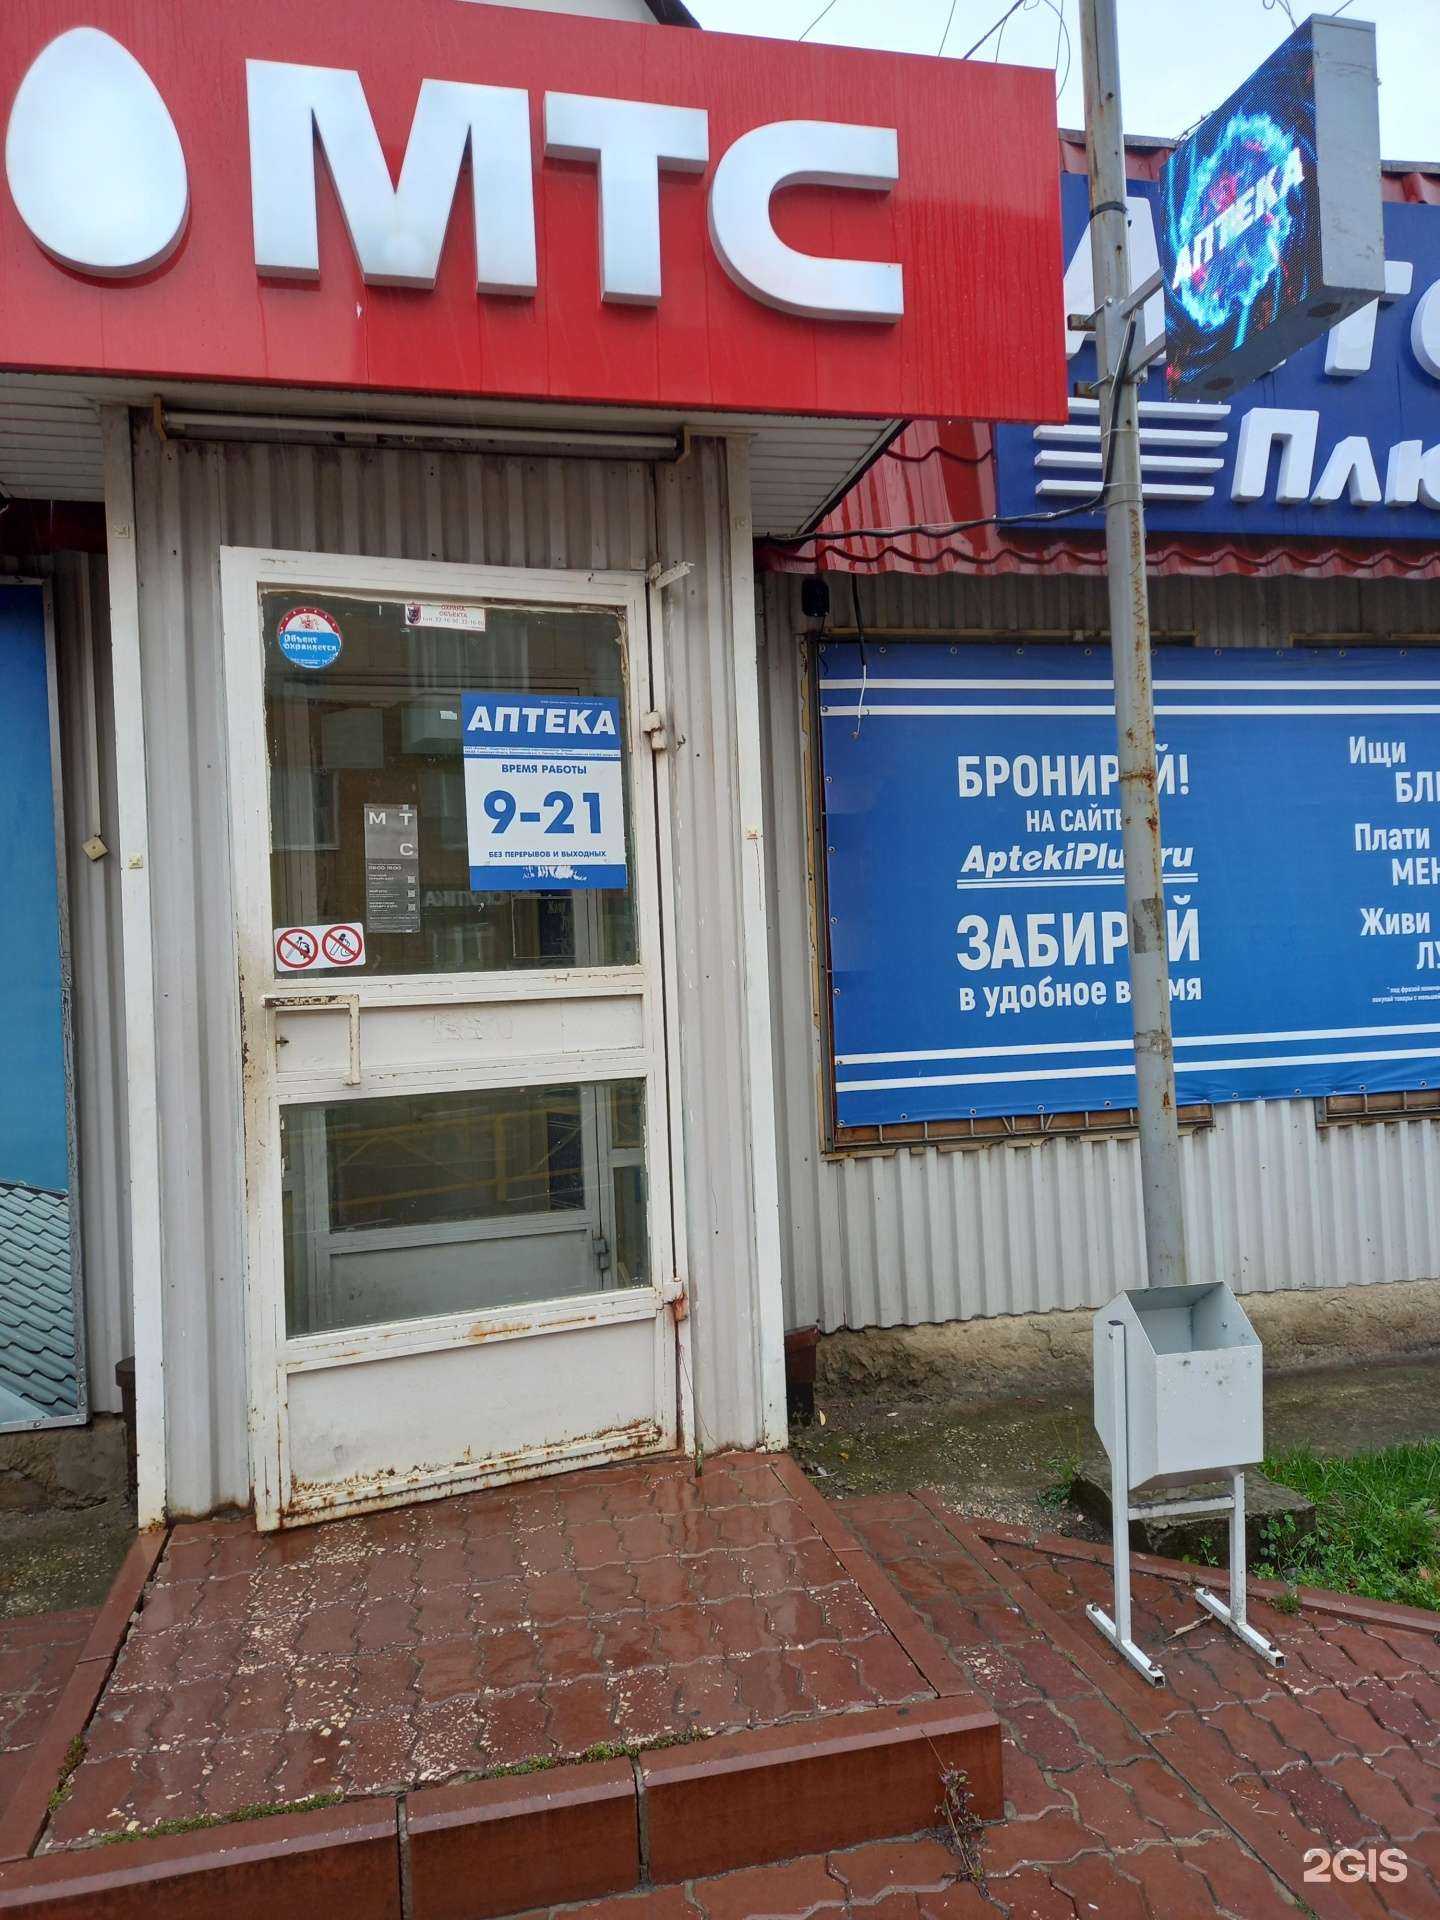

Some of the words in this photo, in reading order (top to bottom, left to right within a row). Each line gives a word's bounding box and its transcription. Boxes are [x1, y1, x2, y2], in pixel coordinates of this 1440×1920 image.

[245, 57, 904, 324] МТС
[1171, 146, 1305, 290] АПТЕКА
[467, 705, 616, 735] АПТЕКА
[501, 763, 538, 774] ВРЕМЯ
[541, 764, 587, 775] РАБОТЫ
[1349, 736, 1406, 768] Ищи
[957, 743, 1189, 798] БРОНИРЙ!
[483, 789, 602, 834] 9-21
[1026, 810, 1055, 832] НА
[1355, 823, 1430, 851] Плати
[488, 851, 502, 859] БЕЗ
[505, 851, 551, 859] ПЕРЕРЫВОВ
[561, 850, 607, 858] ВЫХОДНЫХ
[960, 842, 1194, 879] AptekiPluru
[956, 894, 1200, 971] ЗАБИРЙ
[1360, 907, 1430, 936] Живи
[959, 987, 976, 1011] в
[982, 975, 1107, 1018] удобное
[1115, 977, 1202, 1004] вмя
